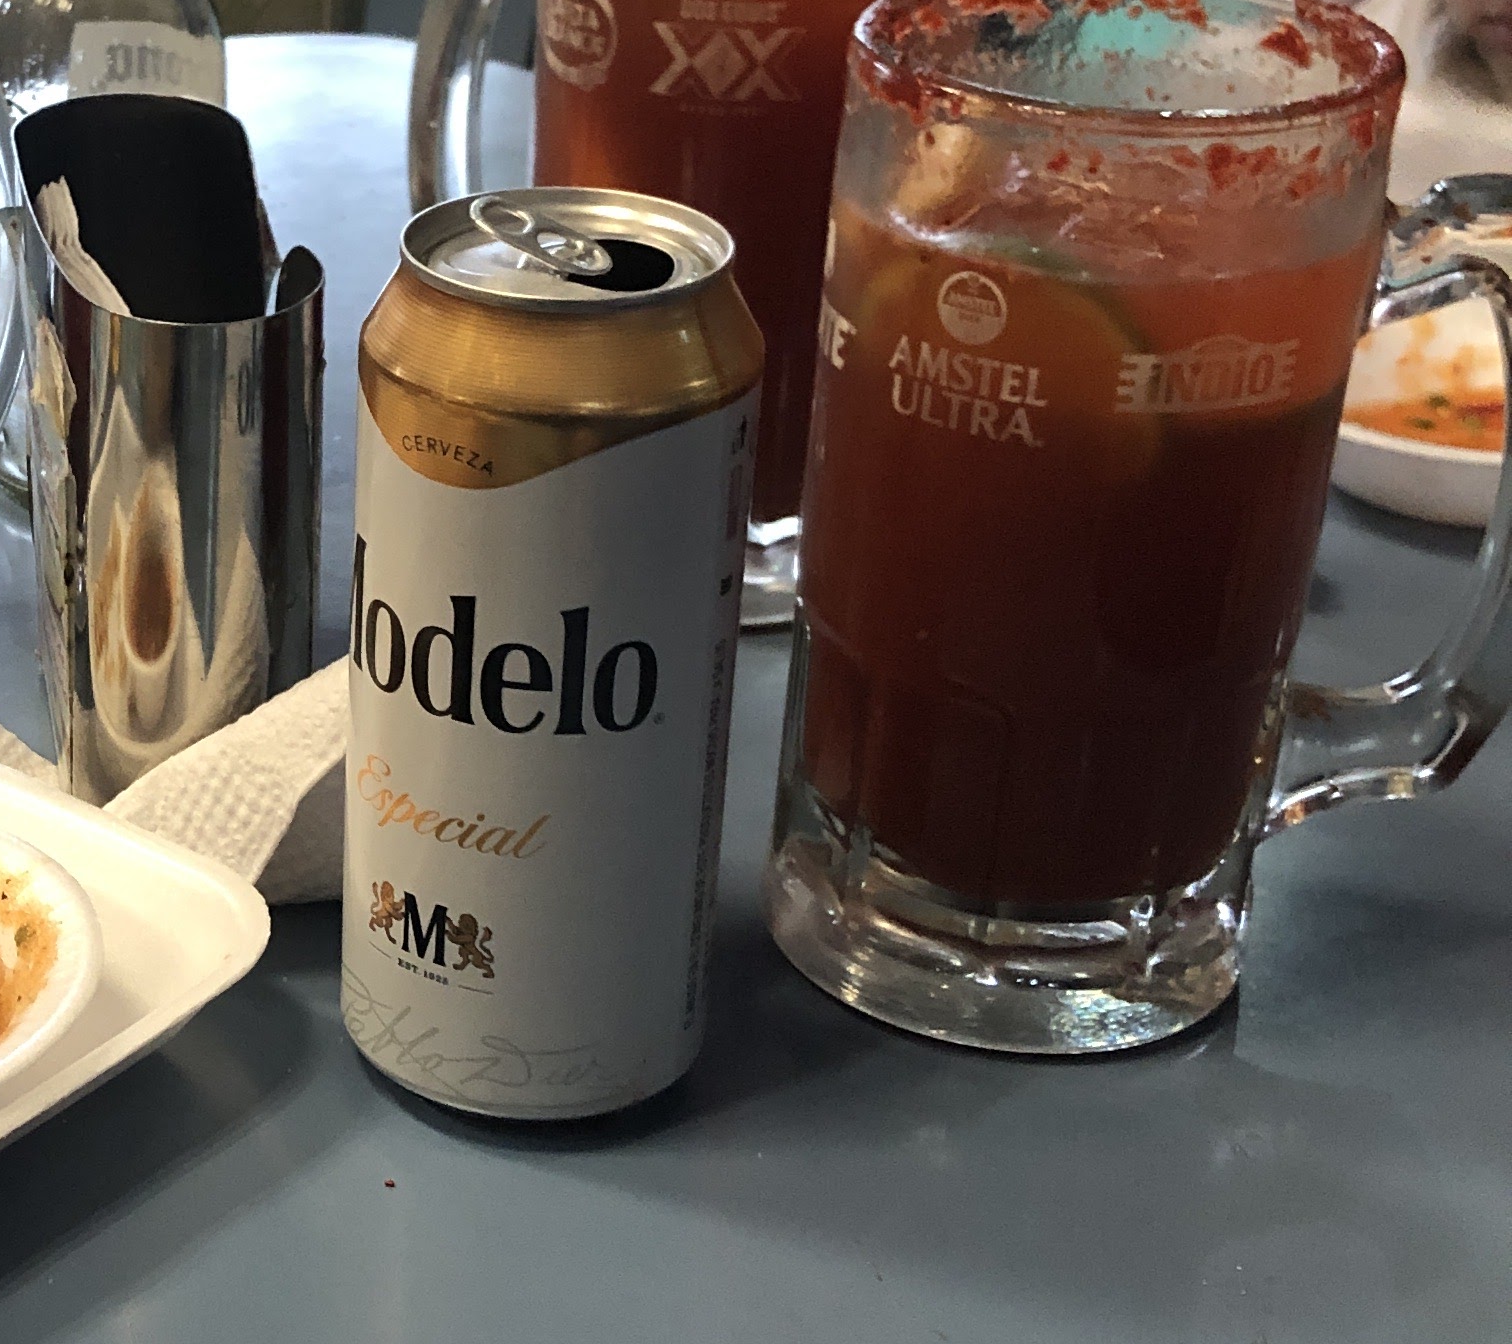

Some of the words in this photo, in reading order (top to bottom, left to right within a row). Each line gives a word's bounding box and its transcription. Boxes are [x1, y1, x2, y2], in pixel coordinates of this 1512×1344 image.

[888, 334, 1049, 407] AMSTEL
[891, 373, 1040, 448] ULTRA
[401, 434, 494, 478] CERVEZA
[356, 754, 552, 859] Especial
[401, 890, 448, 967] M
